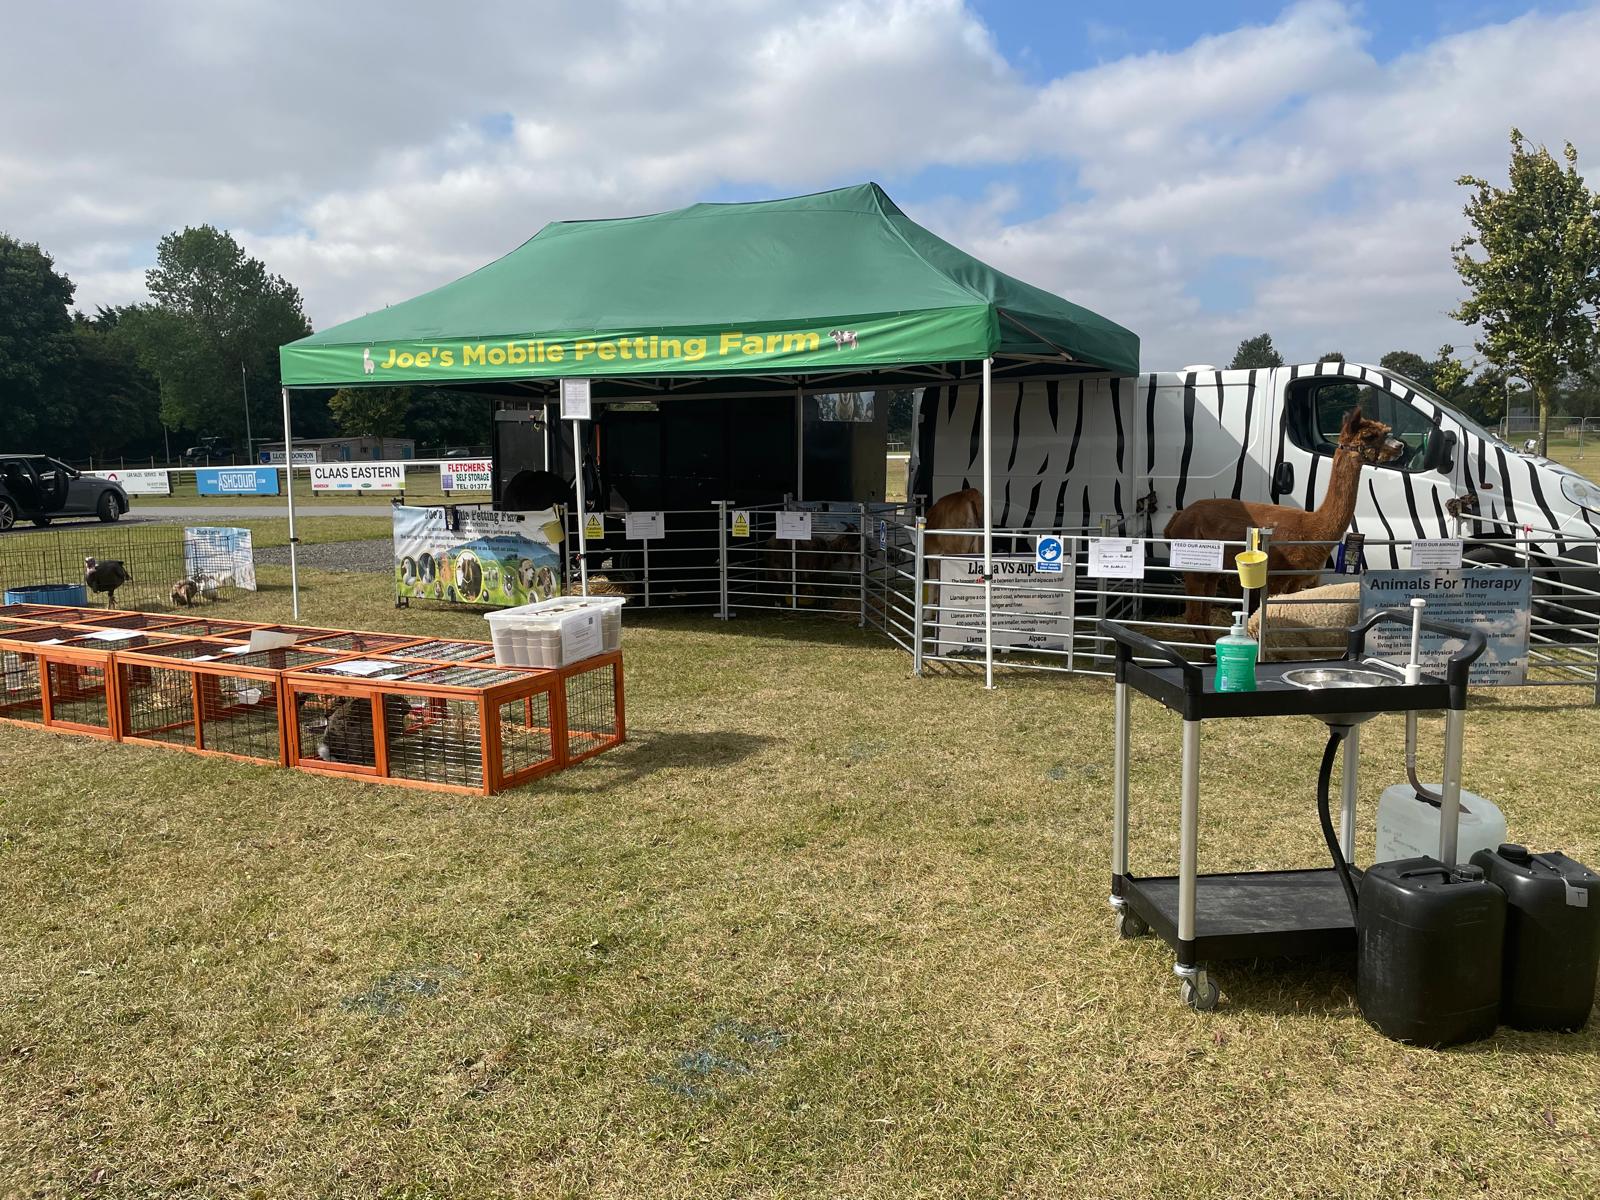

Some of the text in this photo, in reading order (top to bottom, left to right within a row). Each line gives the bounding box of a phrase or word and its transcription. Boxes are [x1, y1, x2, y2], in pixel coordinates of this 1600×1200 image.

[381, 331, 820, 369] Joe's Mobile Petting Farm
[315, 466, 400, 479] CLAAS EASTERN
[447, 463, 485, 472] FLETCHERS
[468, 473, 489, 481] STORAGE
[967, 561, 999, 575] Llaa
[1000, 562, 1015, 574] VS
[1370, 577, 1522, 592] Animals For Therapy
[1028, 635, 1047, 643] Alpaca
